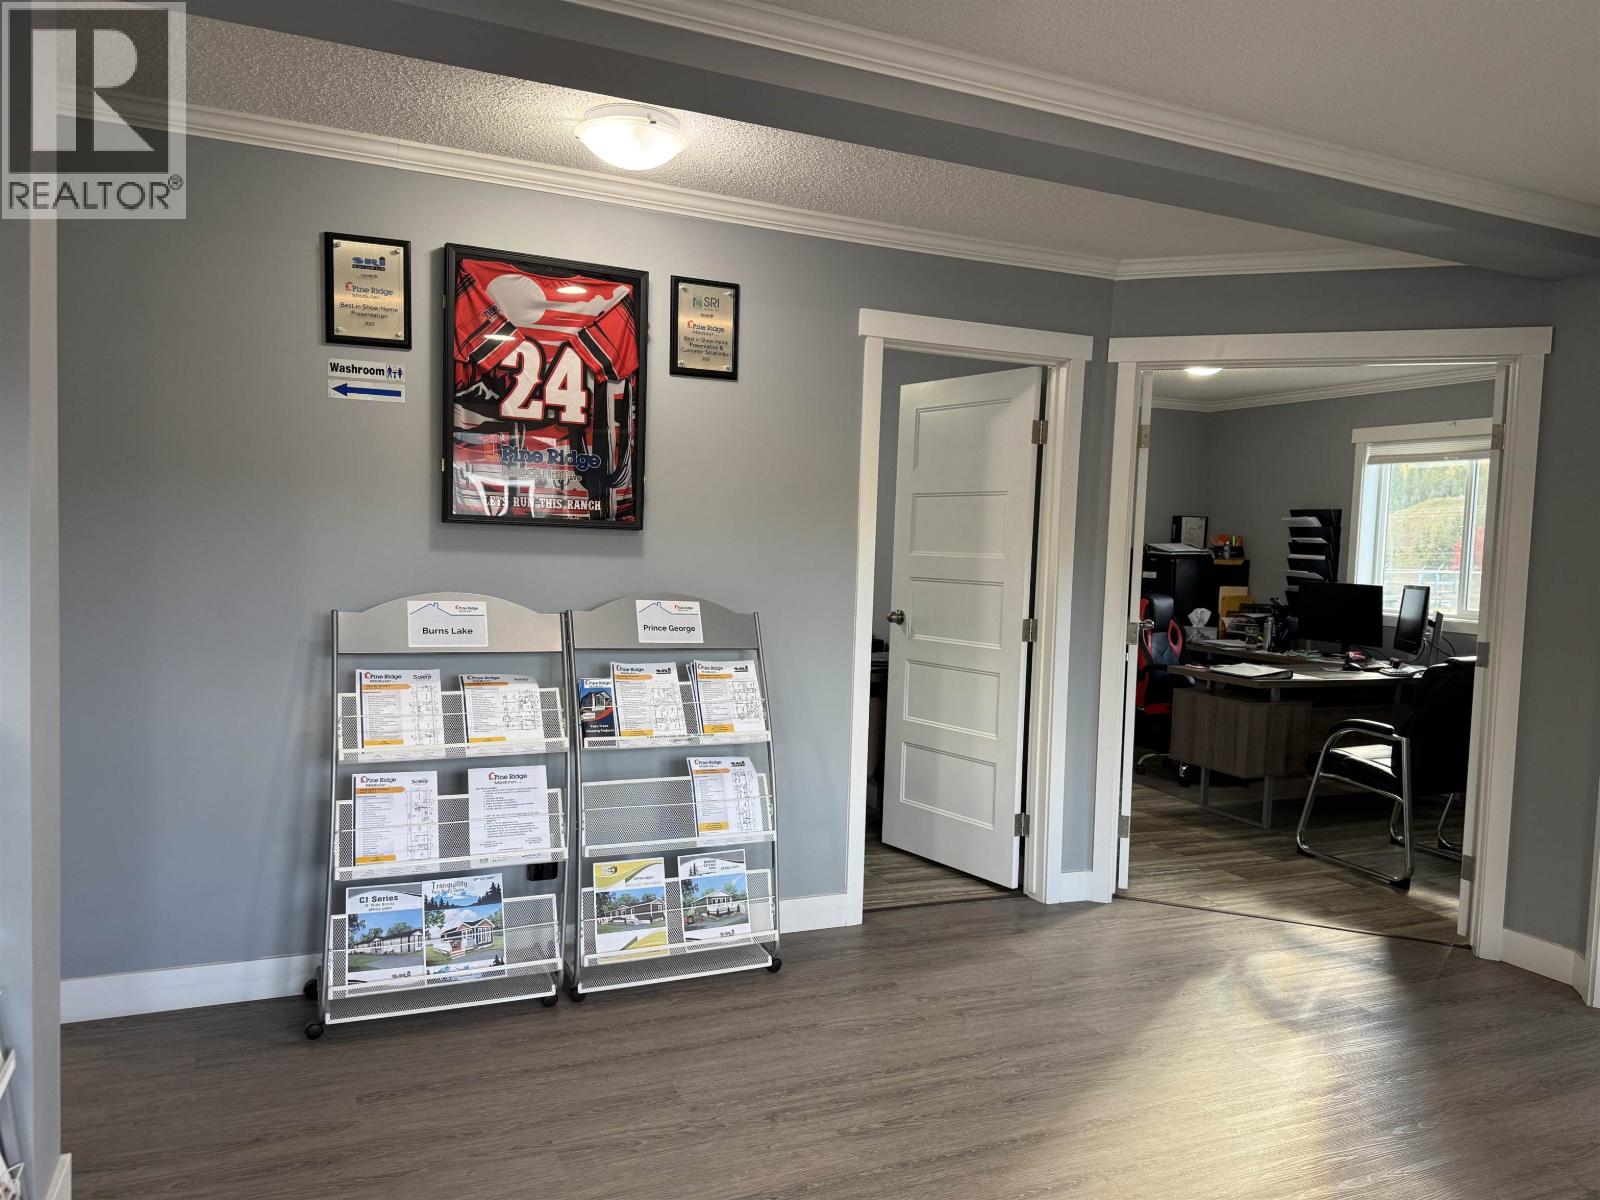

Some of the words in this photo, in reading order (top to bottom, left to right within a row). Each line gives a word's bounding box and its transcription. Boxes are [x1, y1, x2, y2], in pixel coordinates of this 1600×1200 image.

[352, 285, 369, 293] Pine
[371, 286, 393, 296] Ridge
[704, 296, 720, 309] SRI
[692, 323, 706, 331] Pine
[707, 324, 725, 334] Ridge
[329, 362, 385, 376] Washroom
[499, 337, 590, 425] 24
[500, 444, 544, 464] Pine
[546, 447, 602, 472] Ridge
[513, 496, 536, 508] RUN
[539, 497, 563, 510] THIS
[567, 499, 602, 511] RANCH
[422, 627, 449, 635] Burns
[451, 627, 473, 635] Lake
[643, 624, 667, 632] Prince
[668, 624, 696, 633] George
[371, 895, 399, 903] Series
